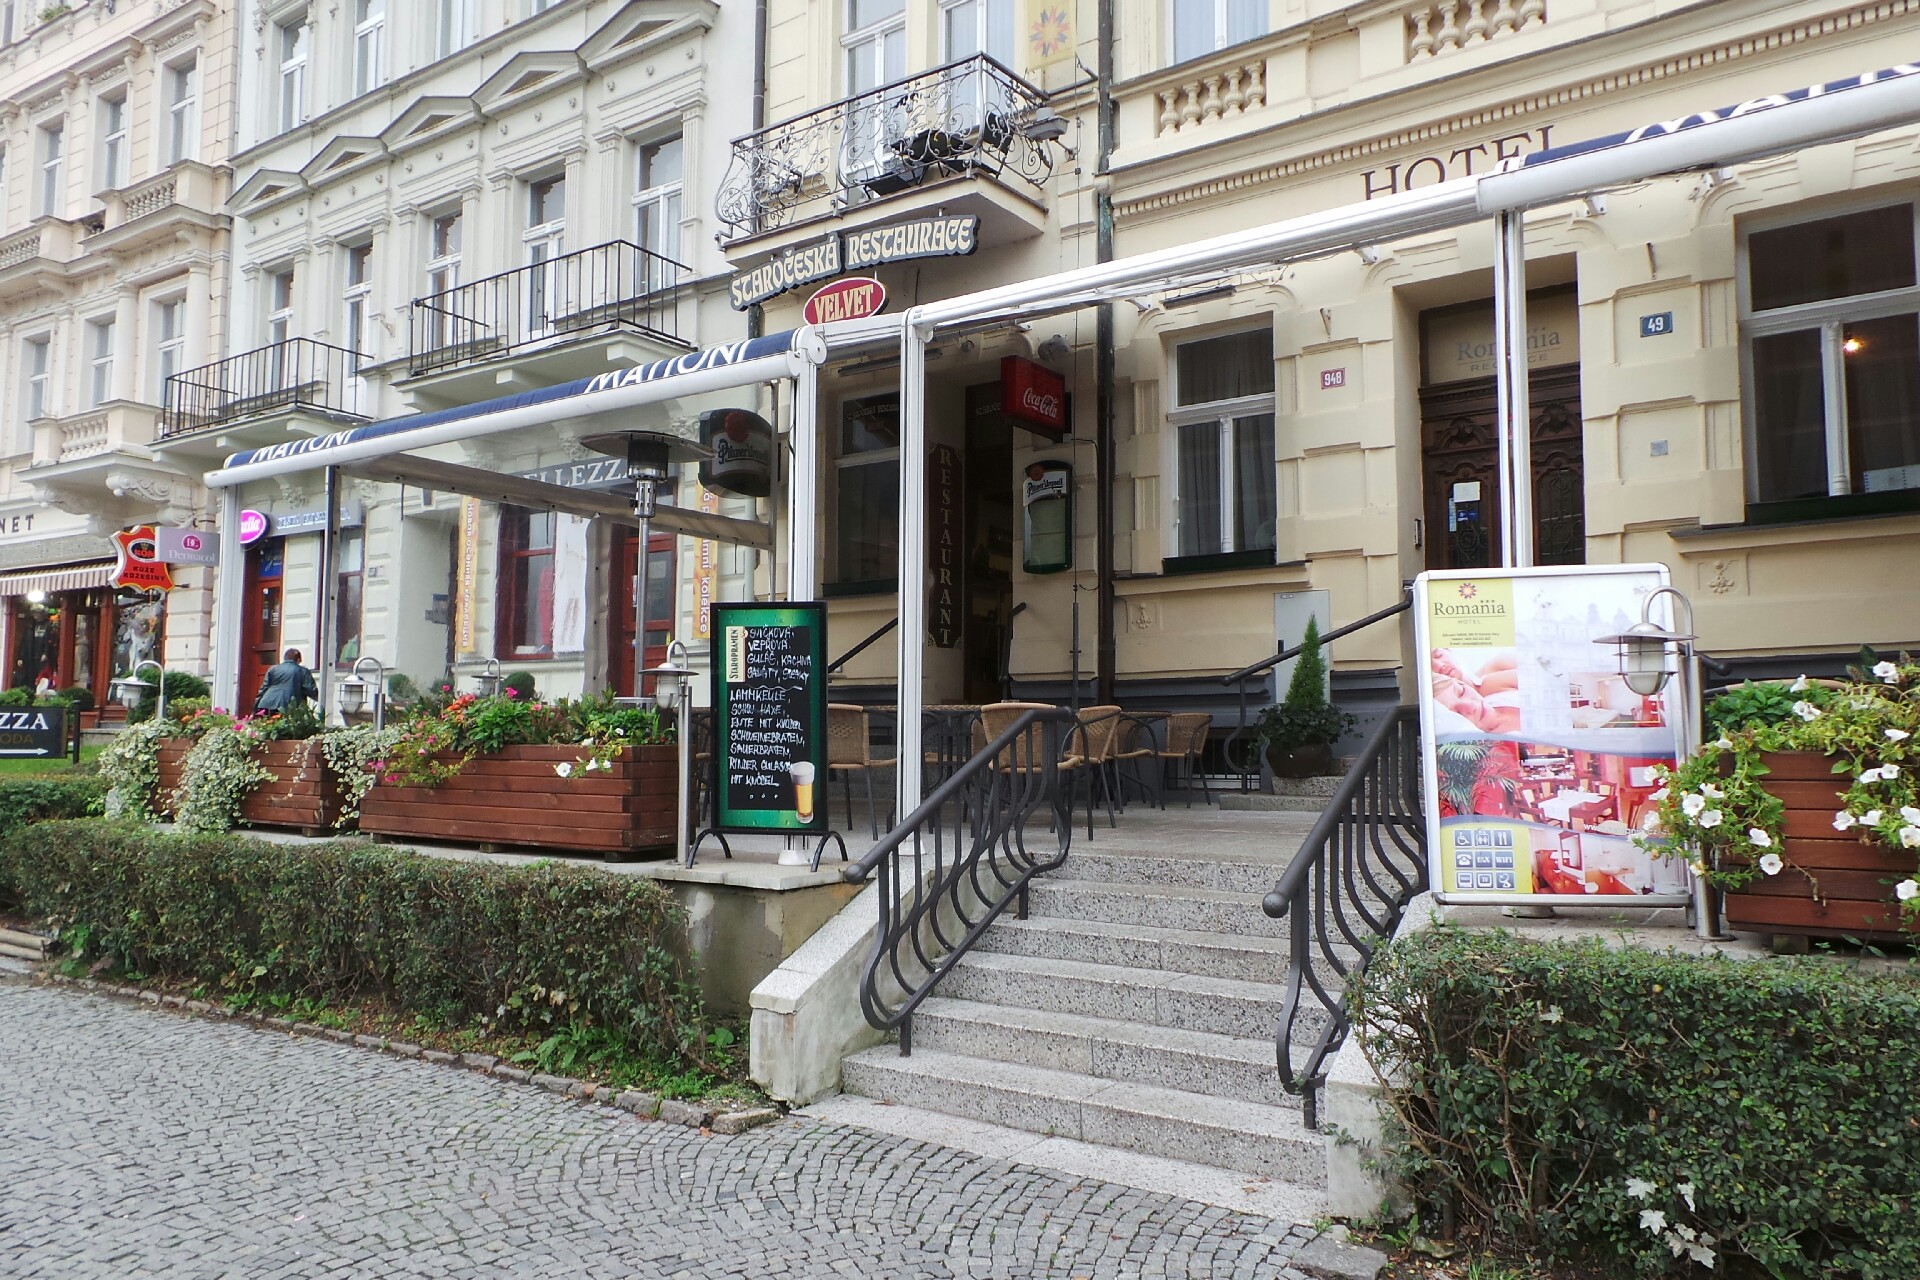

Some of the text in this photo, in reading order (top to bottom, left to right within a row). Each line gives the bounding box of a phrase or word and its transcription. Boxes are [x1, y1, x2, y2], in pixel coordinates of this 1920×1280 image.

[731, 218, 974, 306] STAROČESKÁ RESTAURACE
[813, 284, 875, 324] VELVET
[1647, 316, 1664, 333] 49
[1324, 371, 1342, 386] 948
[1023, 386, 1059, 419] Coca-Cola
[169, 549, 215, 562] Dermacol
[939, 448, 953, 646] RESTAURANT
[699, 576, 711, 634] kolekce
[1433, 601, 1506, 616] Romania
[729, 629, 739, 679] STAROPRAMEN
[759, 717, 773, 729] MIT
[730, 774, 744, 785] MIT
